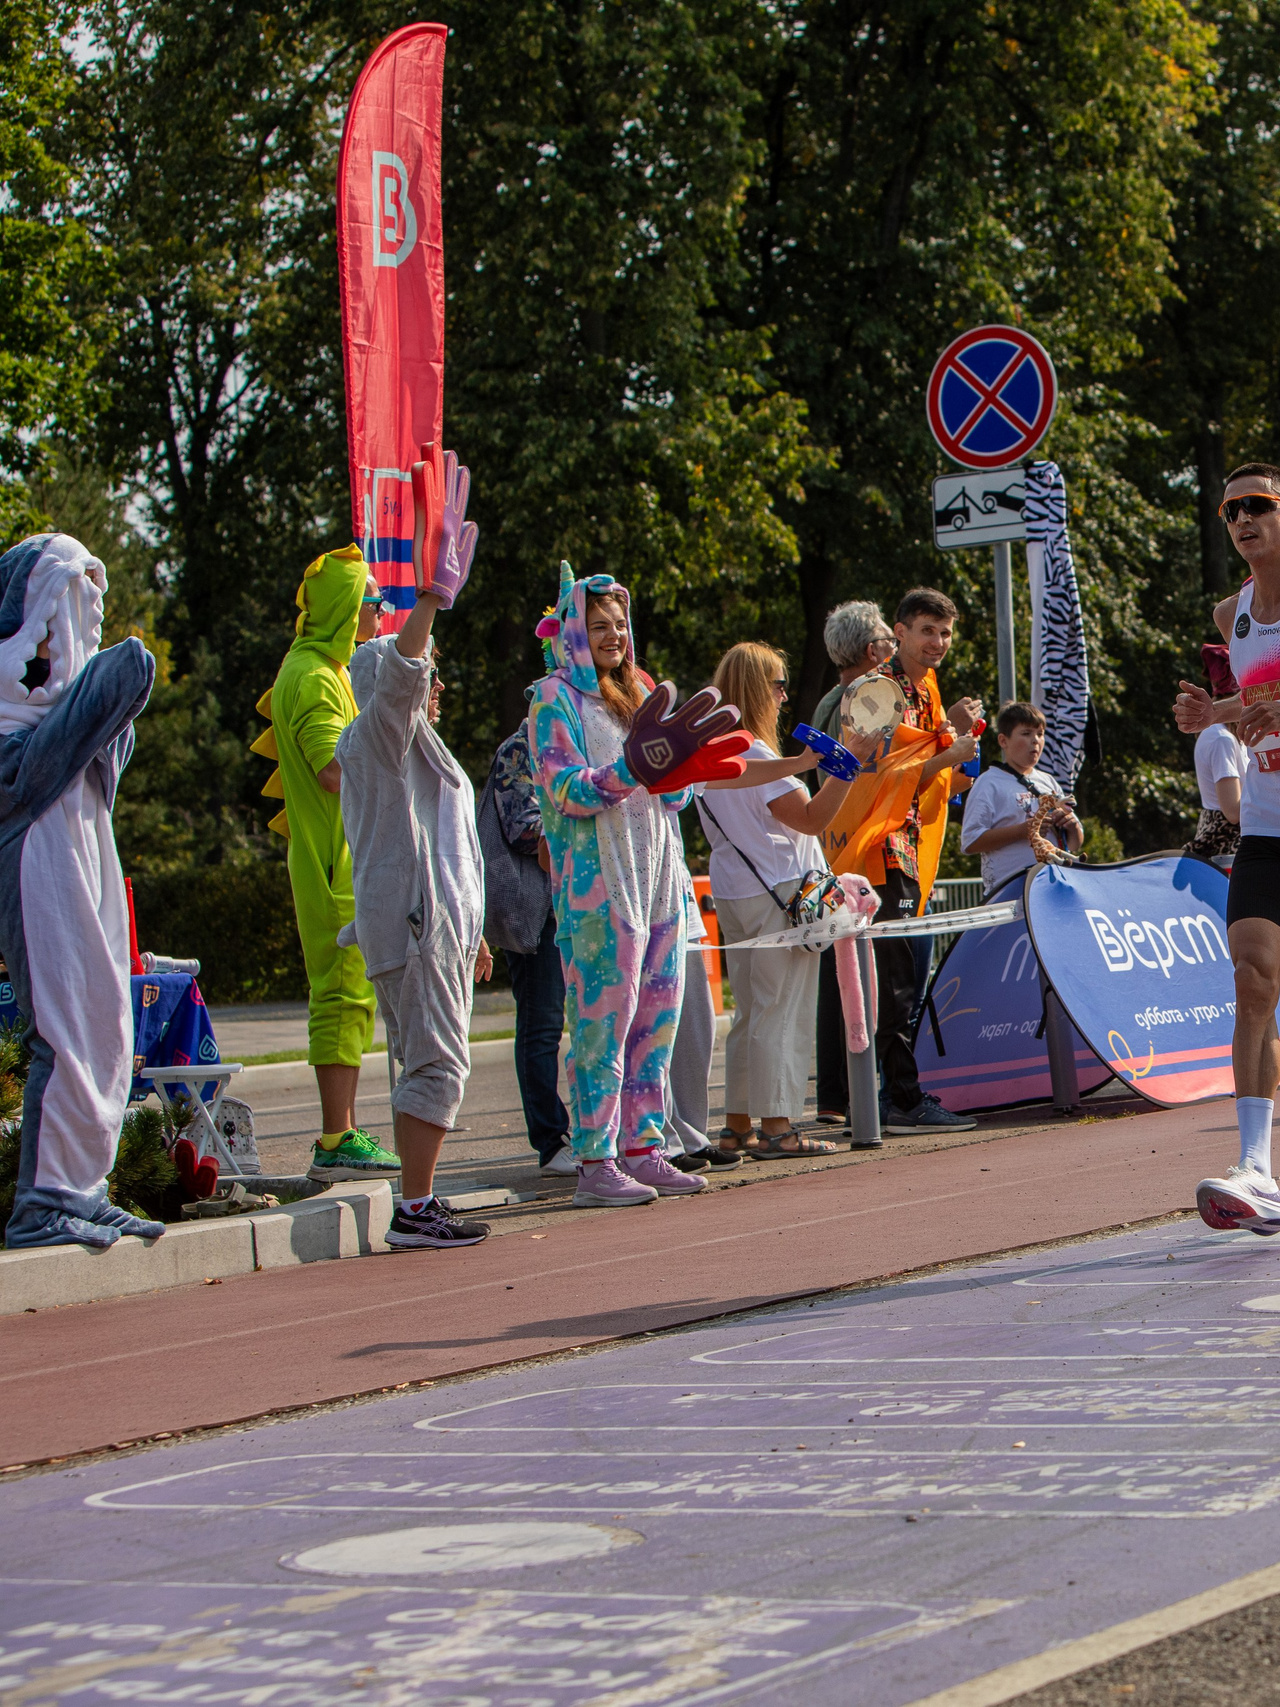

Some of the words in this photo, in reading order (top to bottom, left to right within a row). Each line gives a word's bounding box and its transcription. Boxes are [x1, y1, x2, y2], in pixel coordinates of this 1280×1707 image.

[898, 899, 914, 908] UFC
[1134, 1006, 1185, 1030] суббота
[1189, 1004, 1220, 1025] утро
[857, 1404, 962, 1416] 10
[324, 1481, 862, 1497] поменяйте
